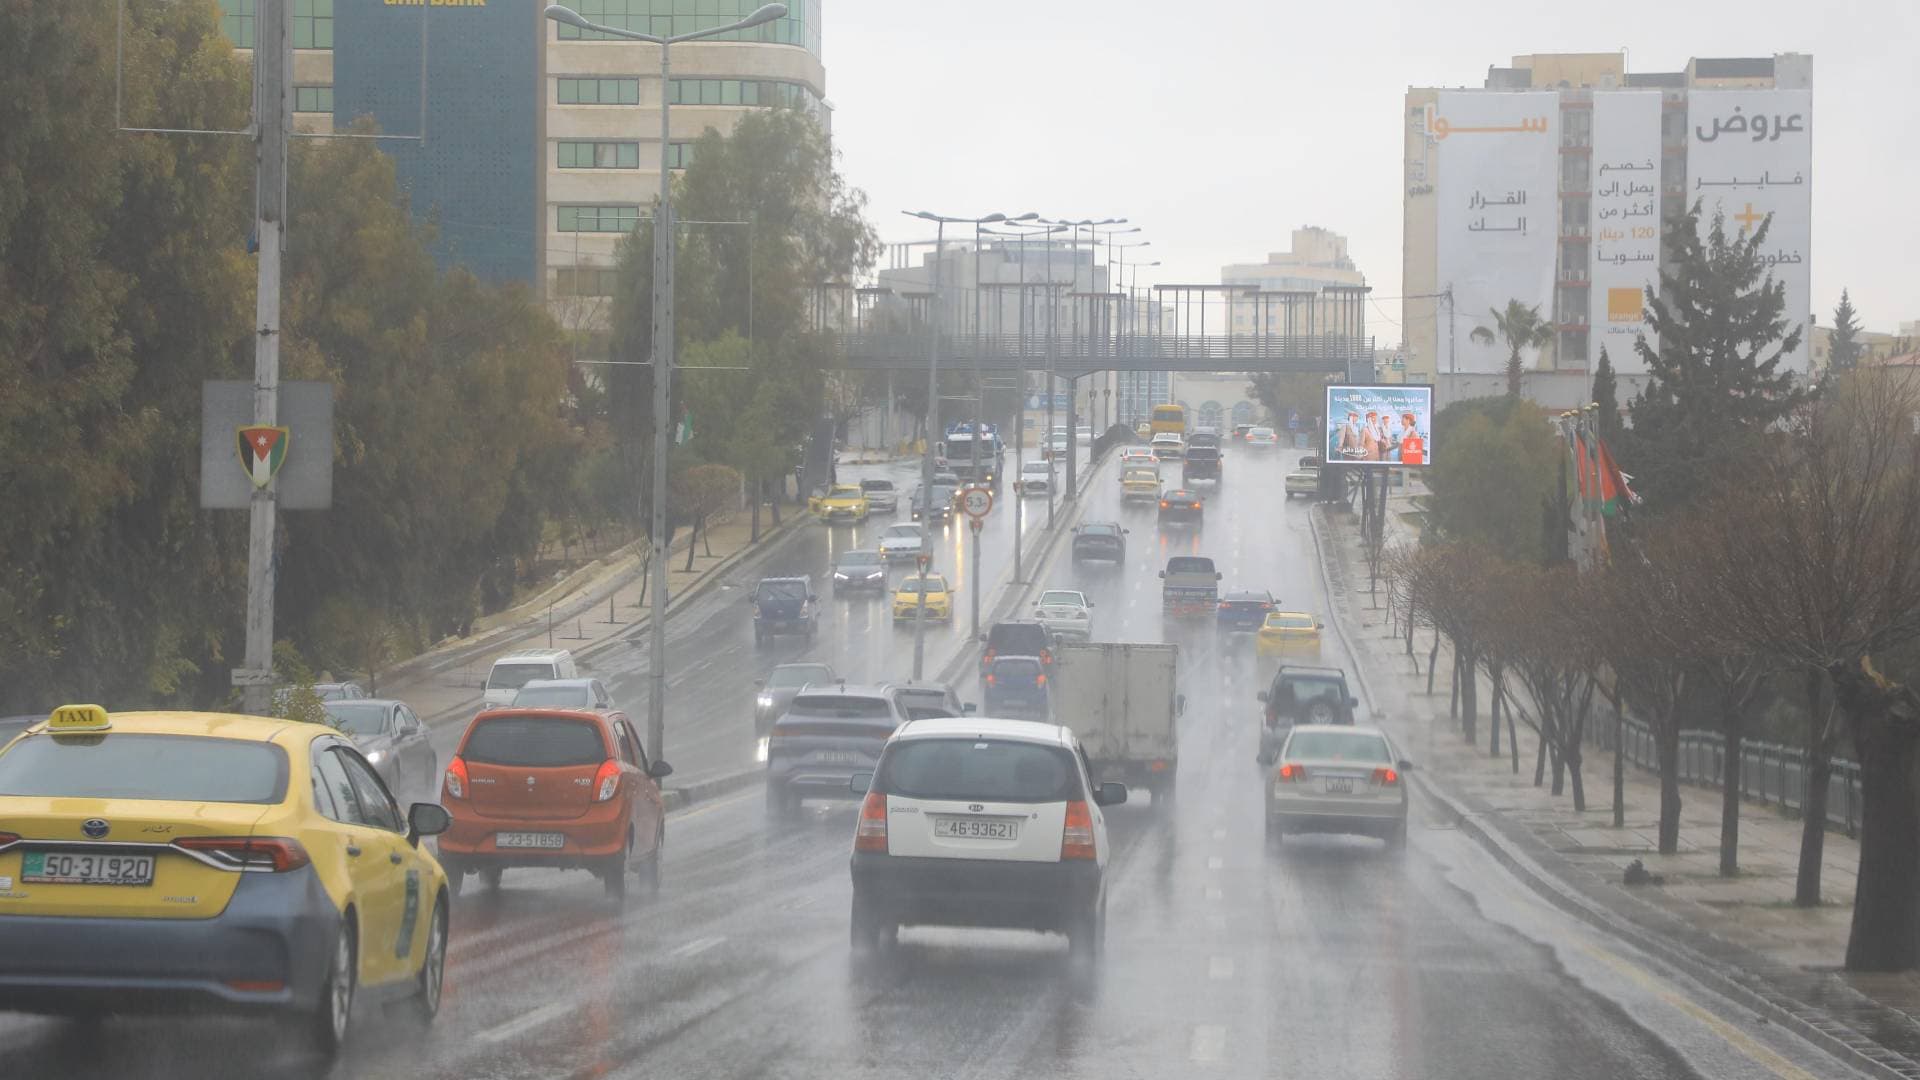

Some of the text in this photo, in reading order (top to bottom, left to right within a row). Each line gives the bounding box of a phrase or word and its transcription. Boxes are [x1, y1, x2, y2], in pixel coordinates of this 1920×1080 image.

[1695, 105, 1804, 143] عروض
[1599, 158, 1654, 177] خصم
[1598, 181, 1654, 197] يصل إلى
[1695, 170, 1803, 191] فايبر
[1468, 189, 1527, 210] القرار
[1599, 200, 1654, 220] أكثر من
[1468, 216, 1527, 237] إلك
[1599, 226, 1655, 242] 120 دينار
[58, 709, 94, 723] TAXI
